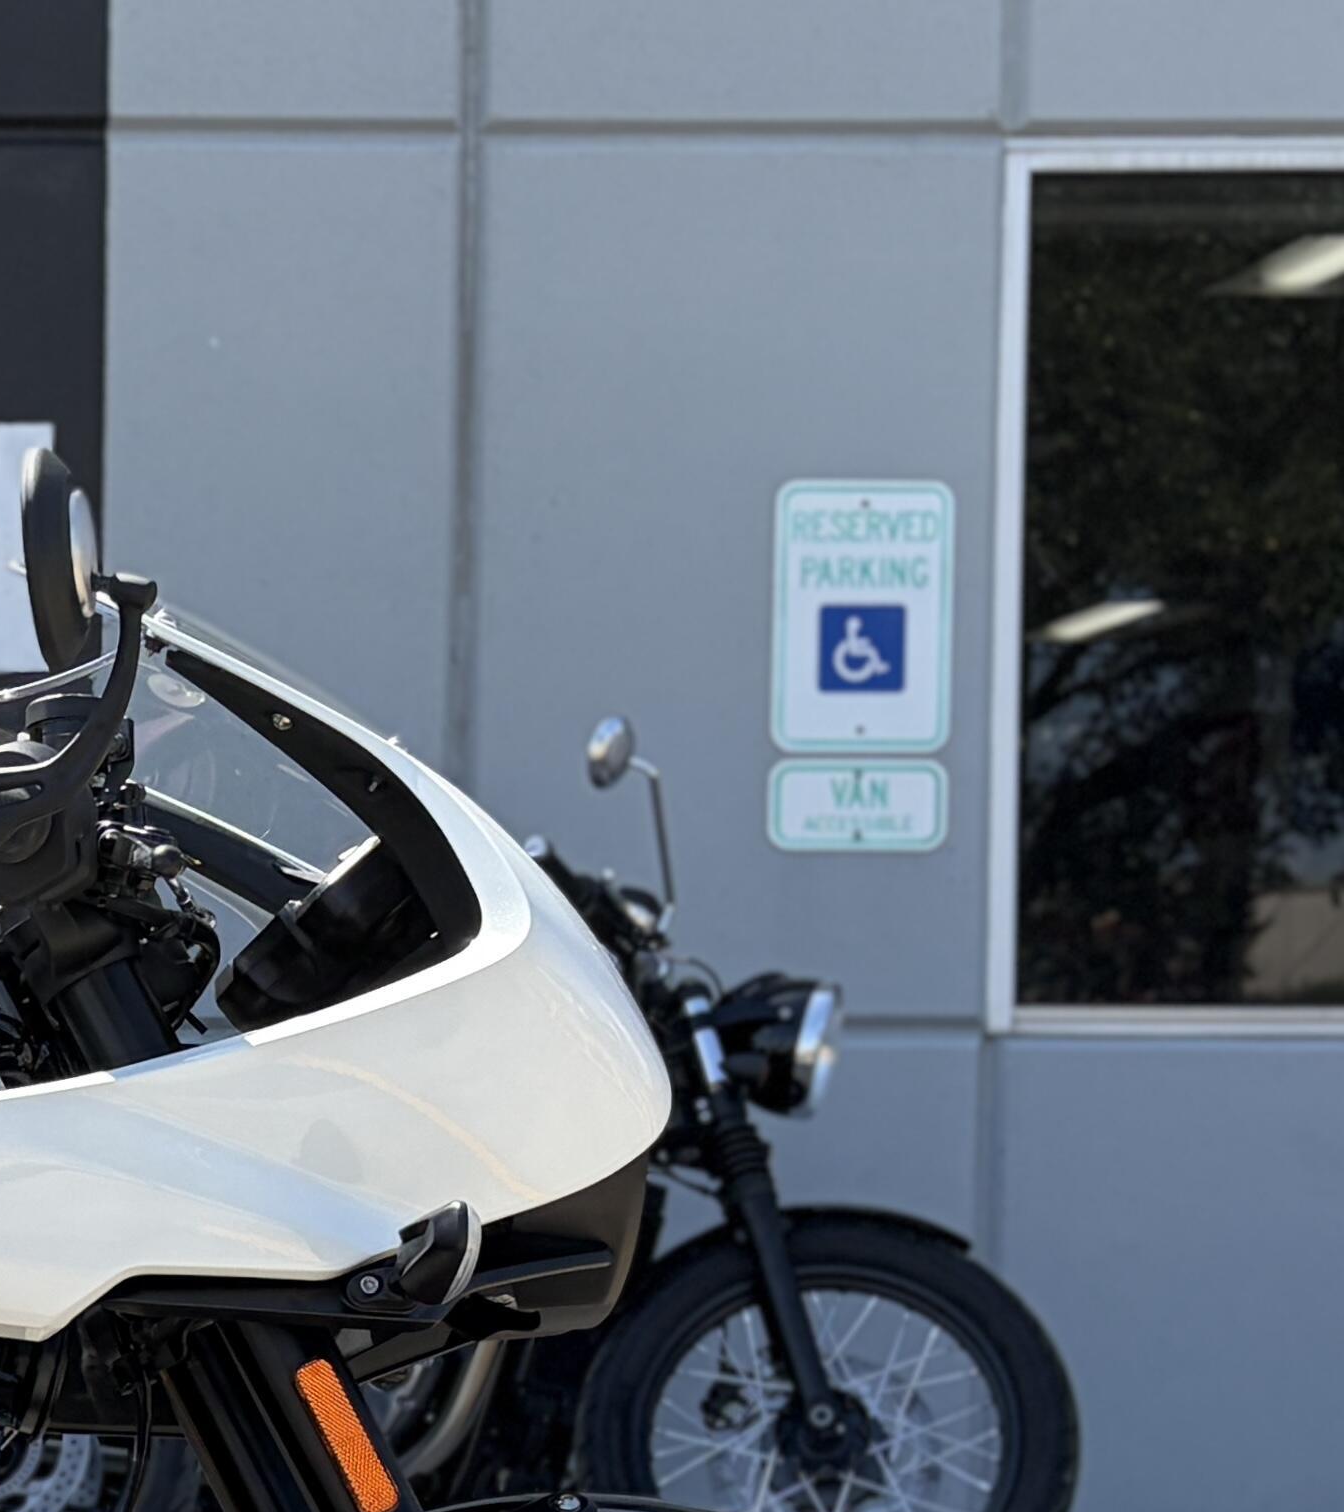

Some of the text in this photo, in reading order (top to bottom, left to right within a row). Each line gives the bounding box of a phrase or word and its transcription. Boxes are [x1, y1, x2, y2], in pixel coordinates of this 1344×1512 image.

[790, 509, 941, 543] RESERVED
[800, 556, 929, 588] PARKING
[829, 777, 889, 809] VAN
